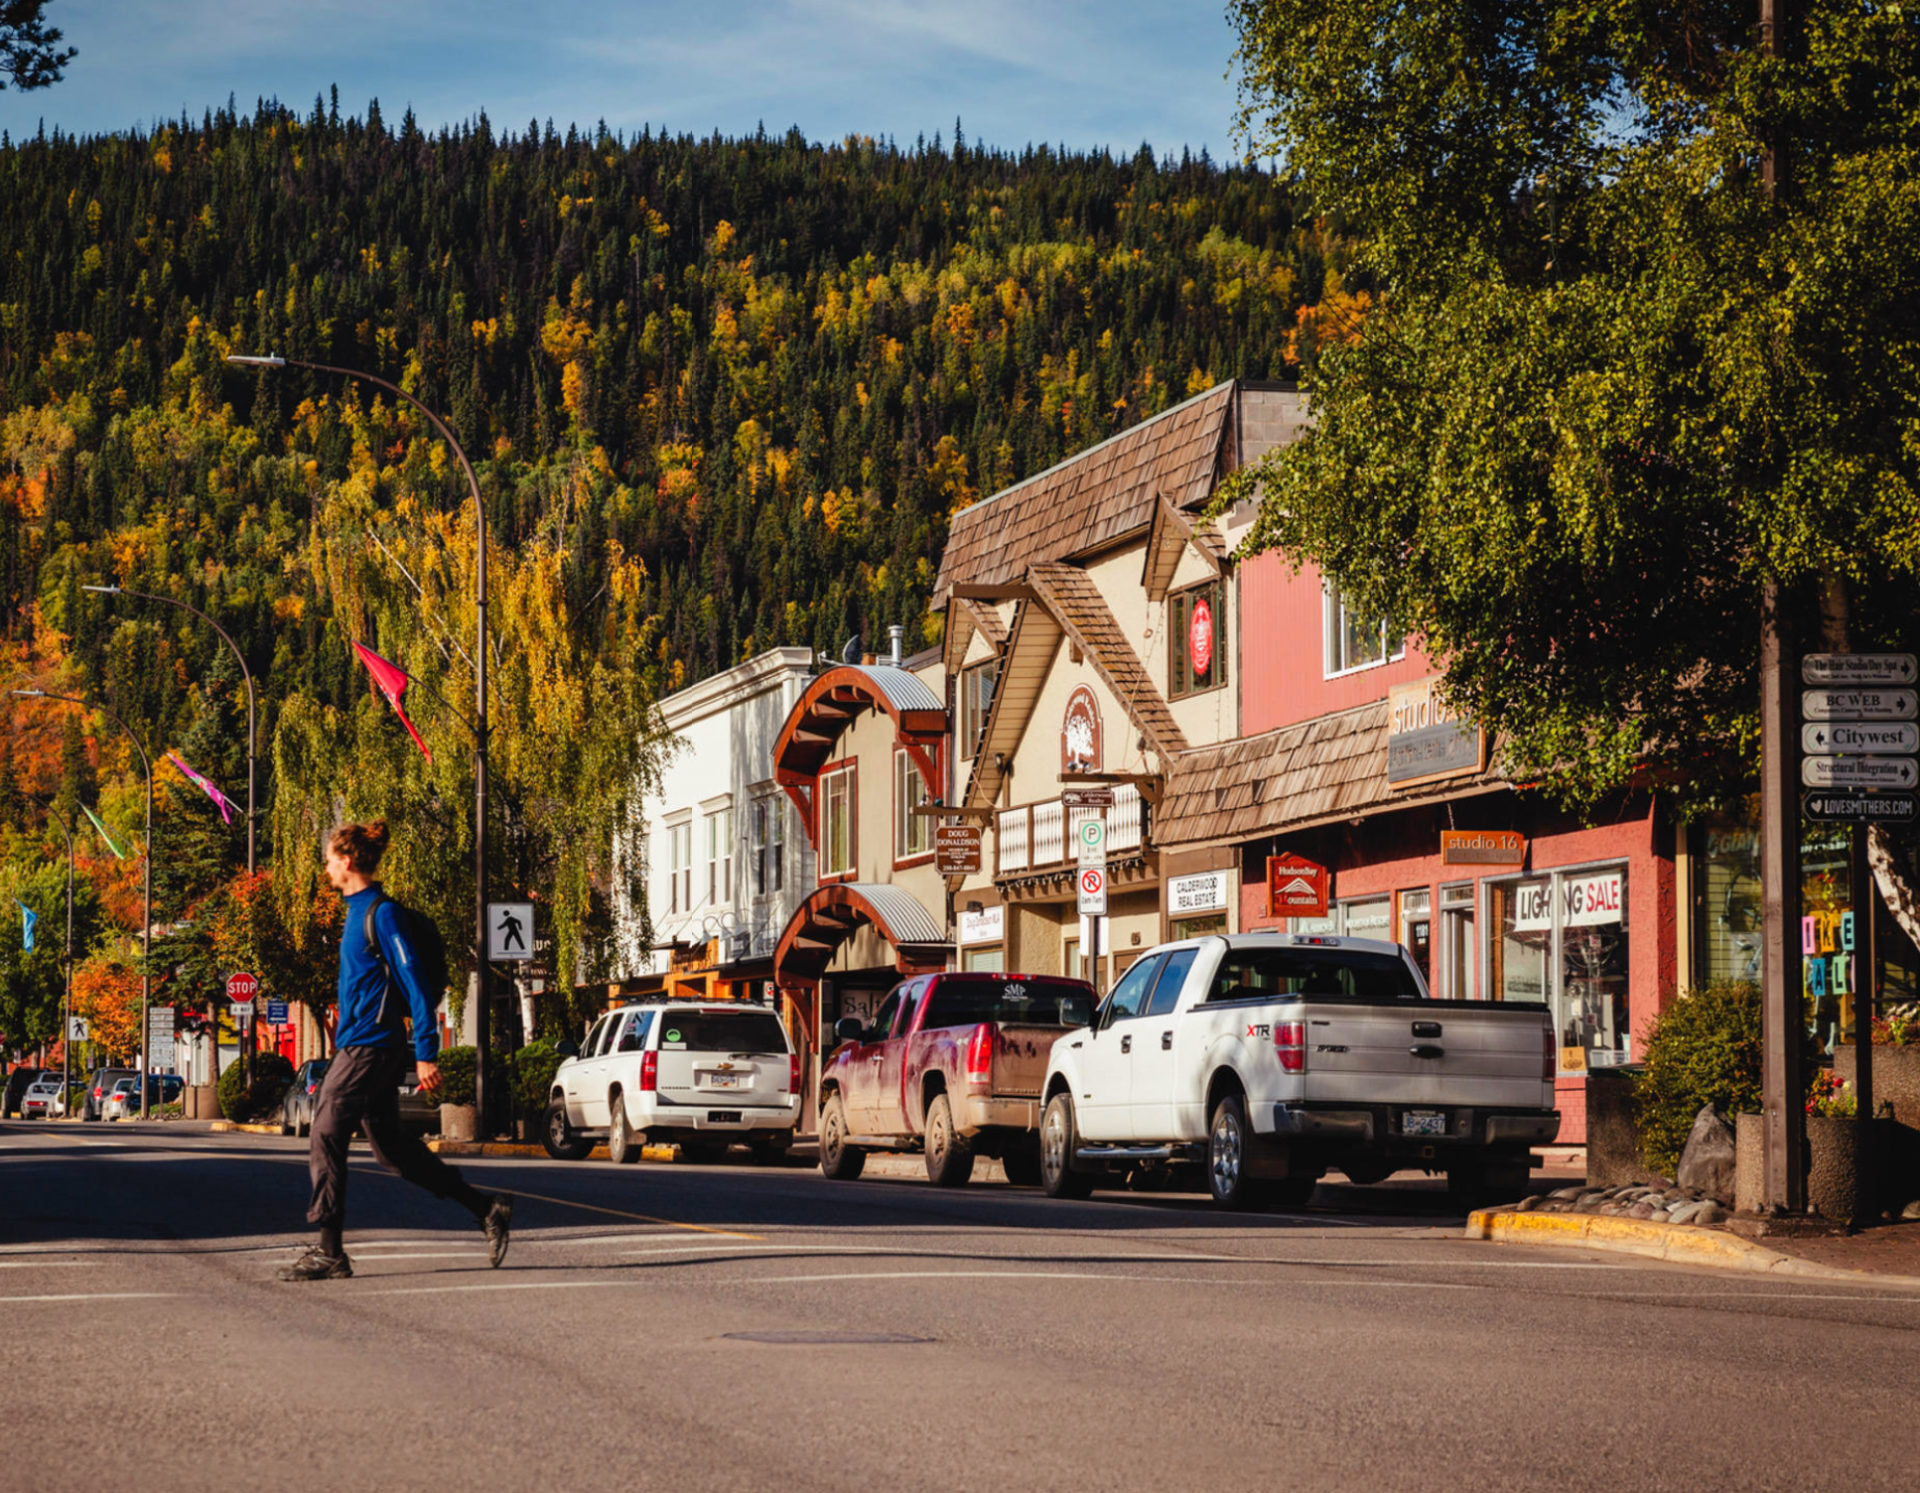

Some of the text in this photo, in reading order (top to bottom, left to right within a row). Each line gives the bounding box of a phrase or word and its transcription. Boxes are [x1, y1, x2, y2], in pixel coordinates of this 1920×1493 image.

[1393, 682, 1447, 735] studio
[1827, 695, 1880, 706] BC WEB
[1832, 728, 1904, 747] Citywest
[1816, 762, 1898, 776] Structural Integration
[1824, 799, 1913, 815] LOVESMITHERS.COM
[937, 838, 980, 846] DONALDSON
[948, 830, 969, 838] DOUG
[1449, 834, 1518, 850] studio 16
[1176, 877, 1218, 893] CALDERWOOD
[1178, 891, 1217, 908] REAL ESTATE
[1521, 880, 1619, 920] LIGHNG SALE
[228, 982, 257, 994] STOP
[1246, 1024, 1270, 1037] XTR
